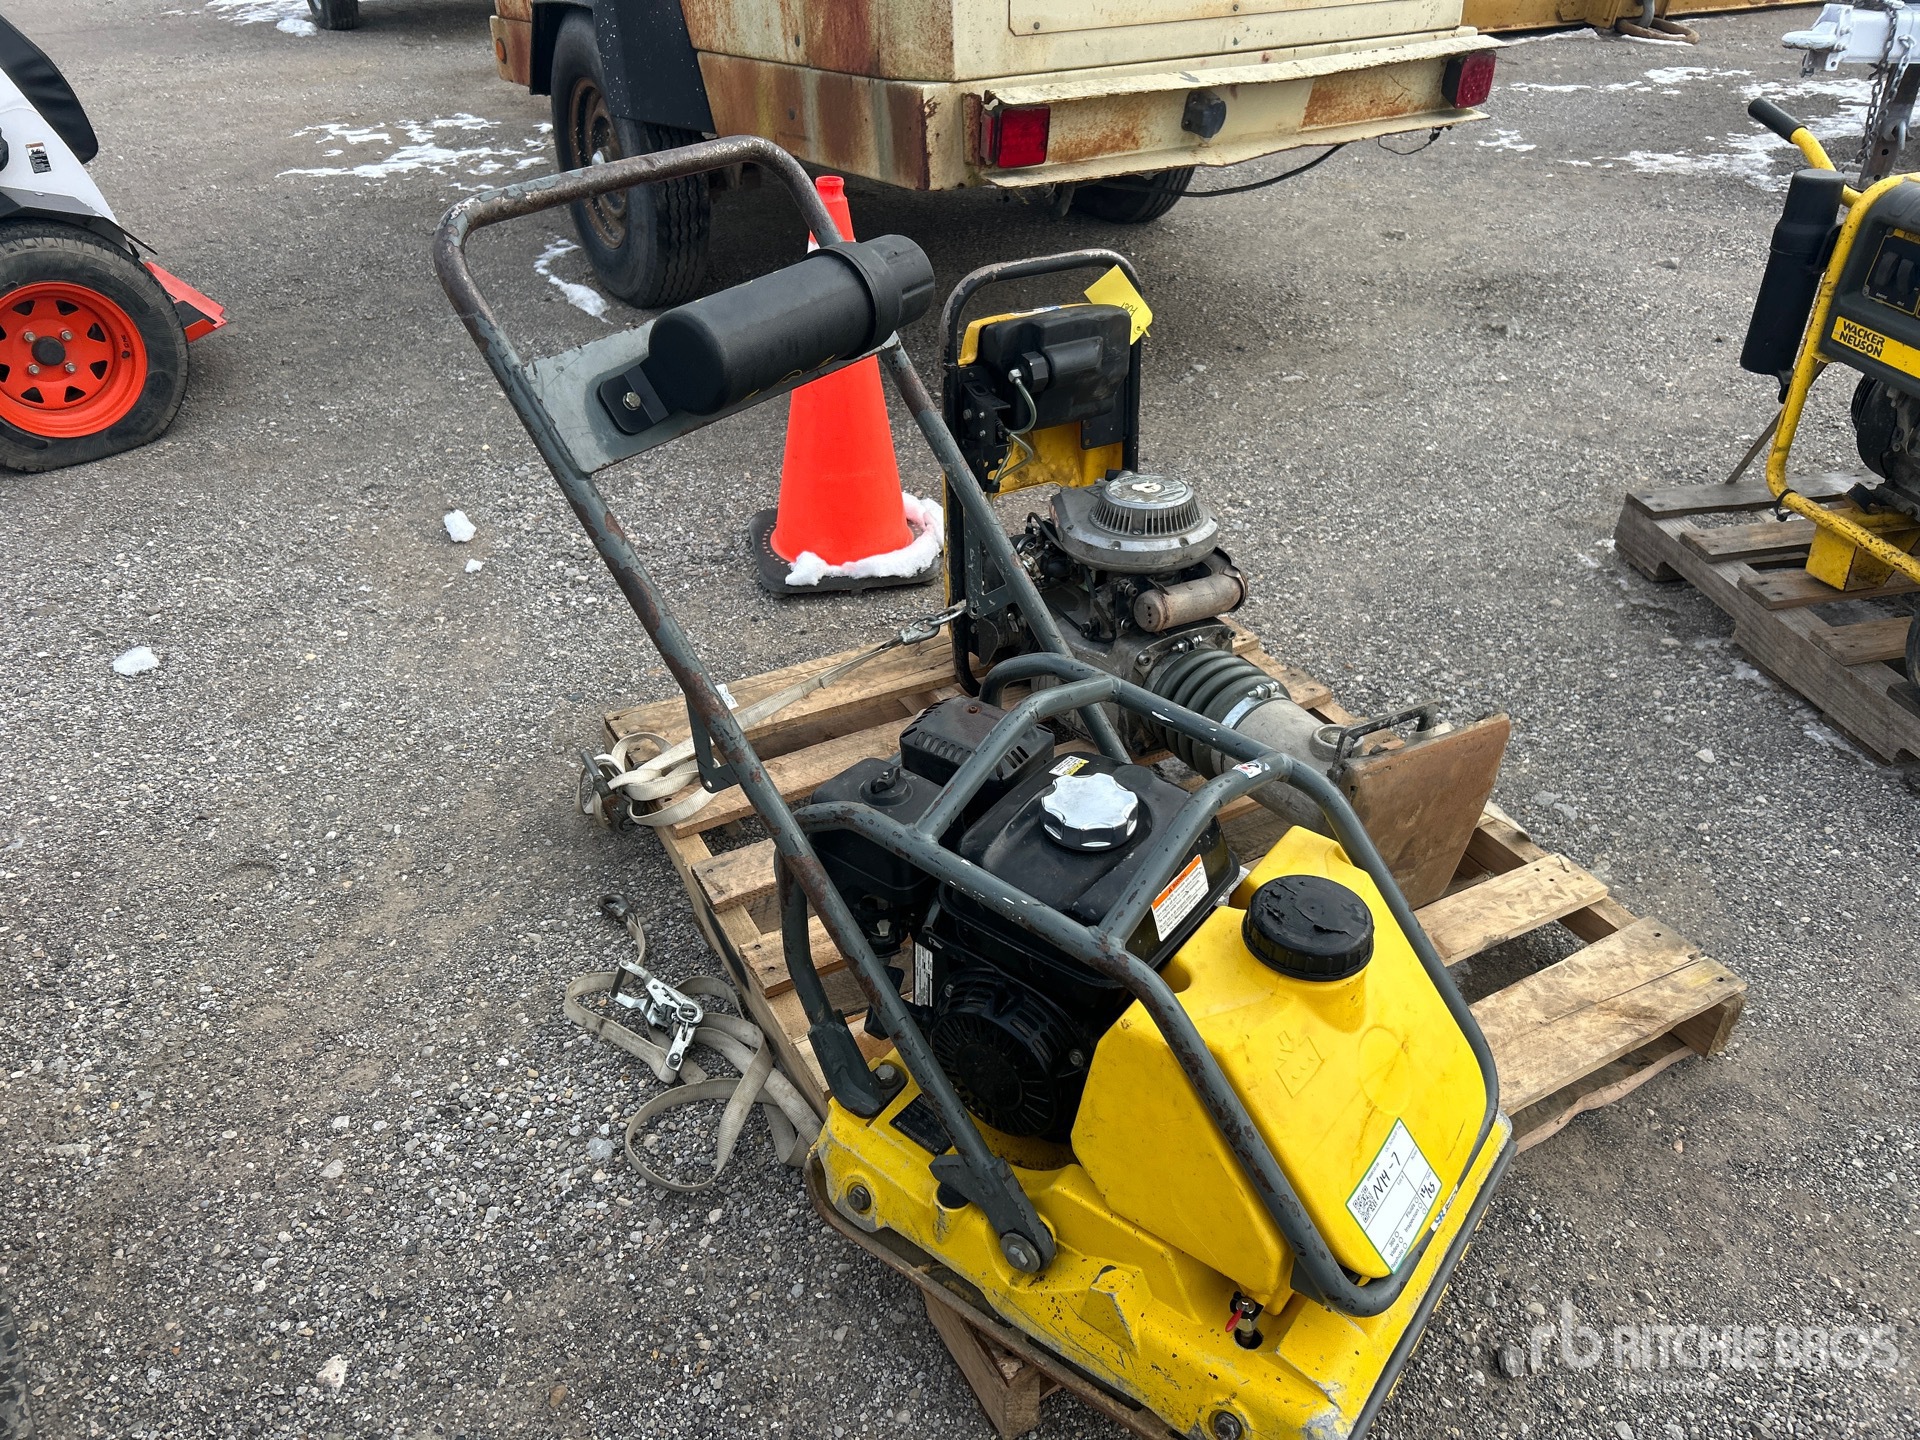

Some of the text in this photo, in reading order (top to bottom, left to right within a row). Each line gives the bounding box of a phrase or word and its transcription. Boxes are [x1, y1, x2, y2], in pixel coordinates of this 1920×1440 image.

[1840, 331, 1883, 357] NEUSON
[1844, 321, 1885, 347] WACKER
[1404, 1208, 1420, 1233] Inspection
[1390, 1243, 1400, 1257] Video
